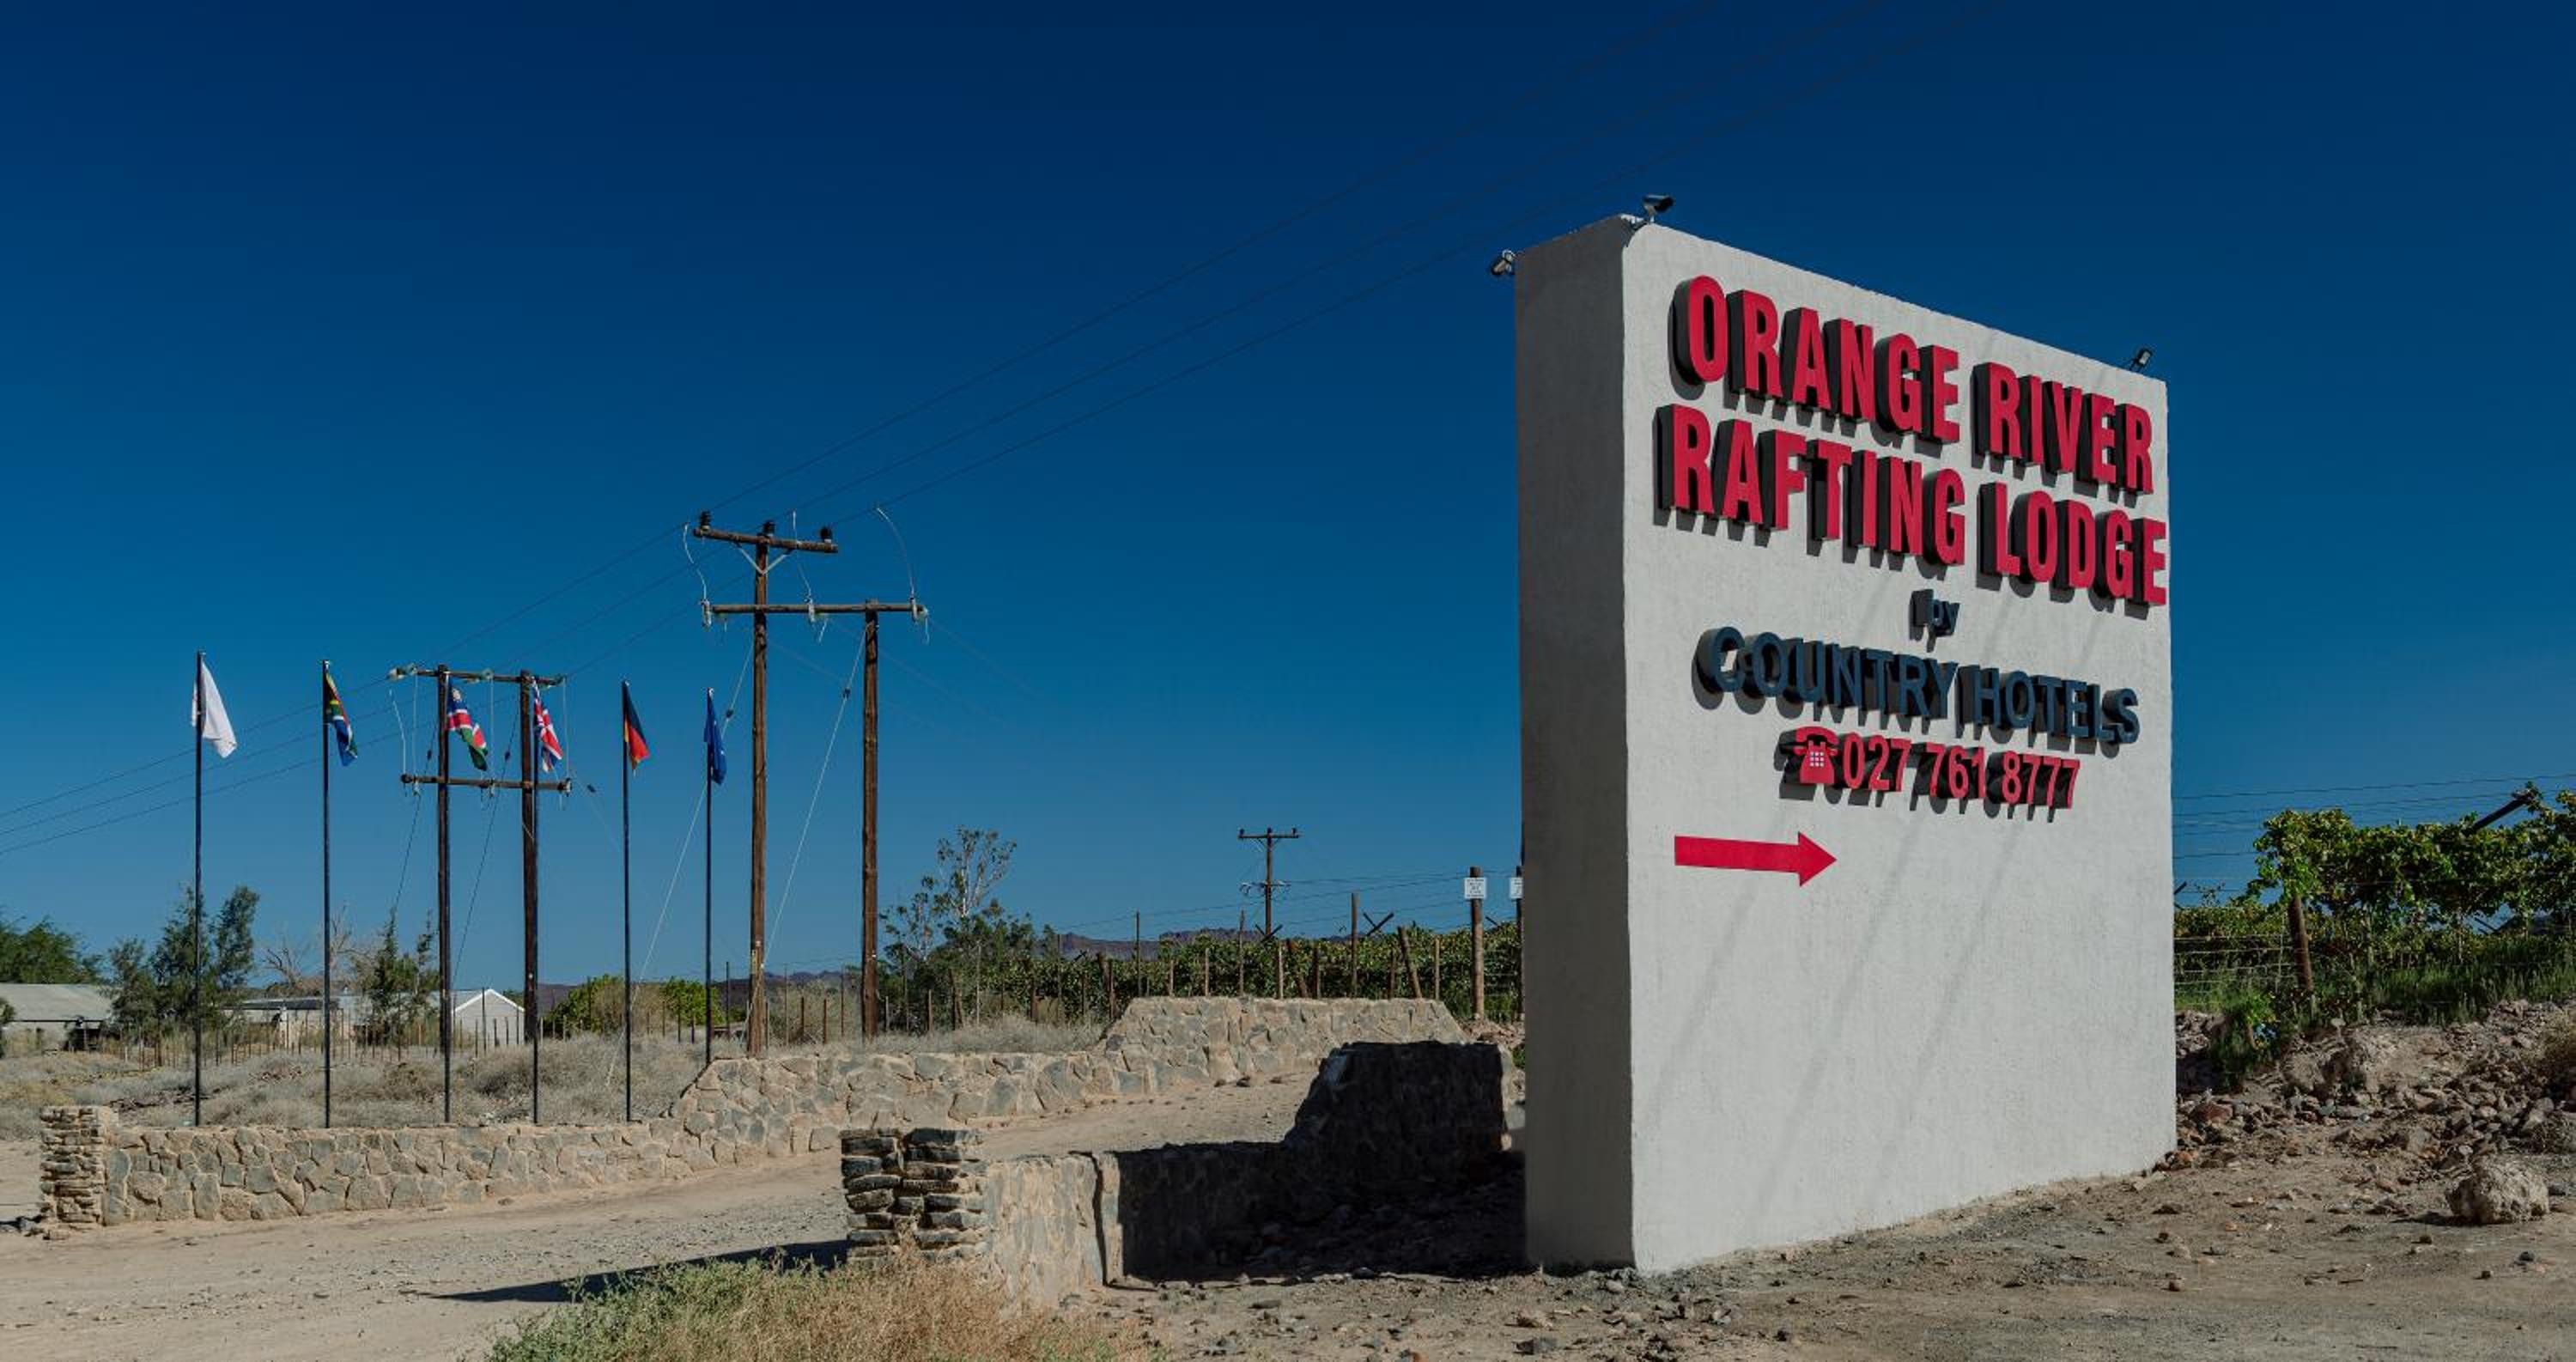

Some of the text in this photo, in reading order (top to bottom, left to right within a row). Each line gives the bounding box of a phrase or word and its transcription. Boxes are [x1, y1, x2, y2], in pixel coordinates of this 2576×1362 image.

[1689, 275, 2154, 495] ORANGE RIVER
[1673, 404, 2166, 605] RAFTING LODGE
[1711, 626, 2140, 744] COUNTRY HOTELS
[1843, 733, 2081, 809] 027 761 8777
